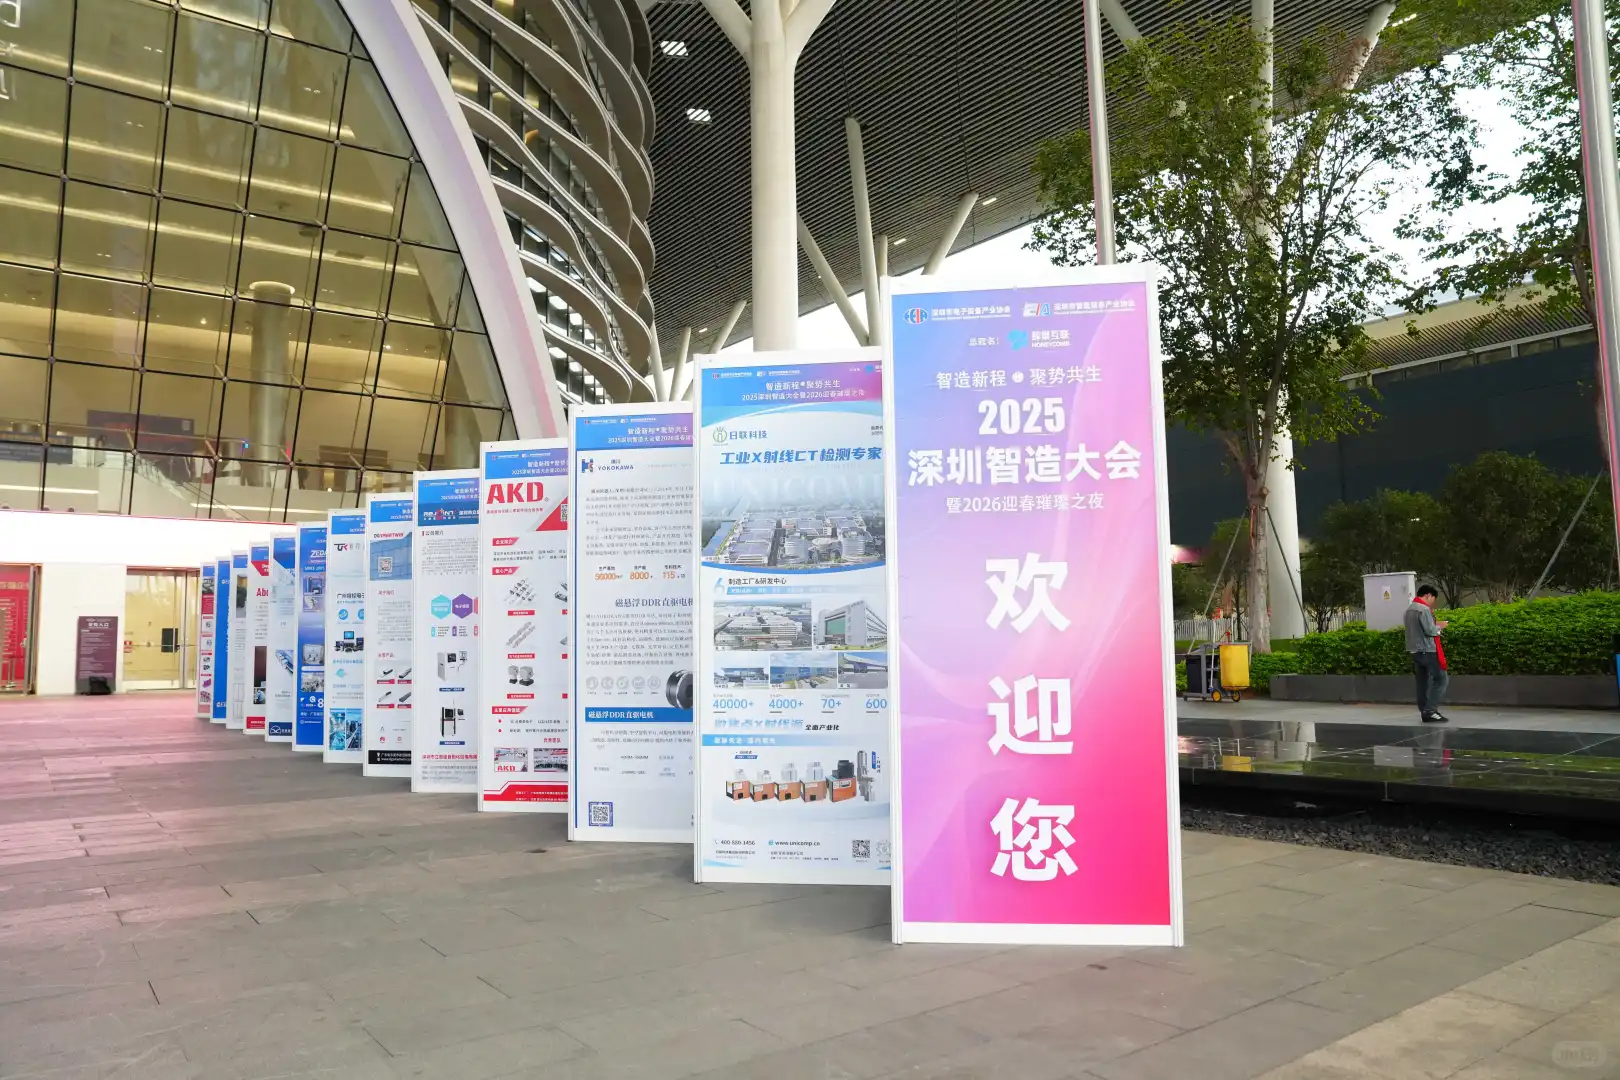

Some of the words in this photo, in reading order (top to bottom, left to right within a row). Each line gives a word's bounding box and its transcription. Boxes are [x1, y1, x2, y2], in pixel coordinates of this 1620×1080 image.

[765, 382, 800, 391] 智造新程
[806, 379, 840, 389] 聚势共生
[936, 369, 1007, 389] 智造新程
[1029, 365, 1102, 386] 聚势共生
[978, 397, 1066, 435] 2025
[729, 430, 768, 440] 日联科技
[719, 446, 883, 465] 工业X射线CT检测专家
[907, 440, 1142, 487] 深圳智造大会
[487, 481, 544, 505] AKD
[946, 492, 1105, 513] 暨2026迎春璀璨之夜
[728, 577, 787, 587] 制造工厂&研发中心
[713, 698, 754, 709] 40000+
[769, 698, 804, 709] 4000+
[821, 698, 842, 709] 70+
[588, 711, 654, 719] 磁悬浮DDR直驱电机
[985, 552, 1079, 882] 欢迎您
